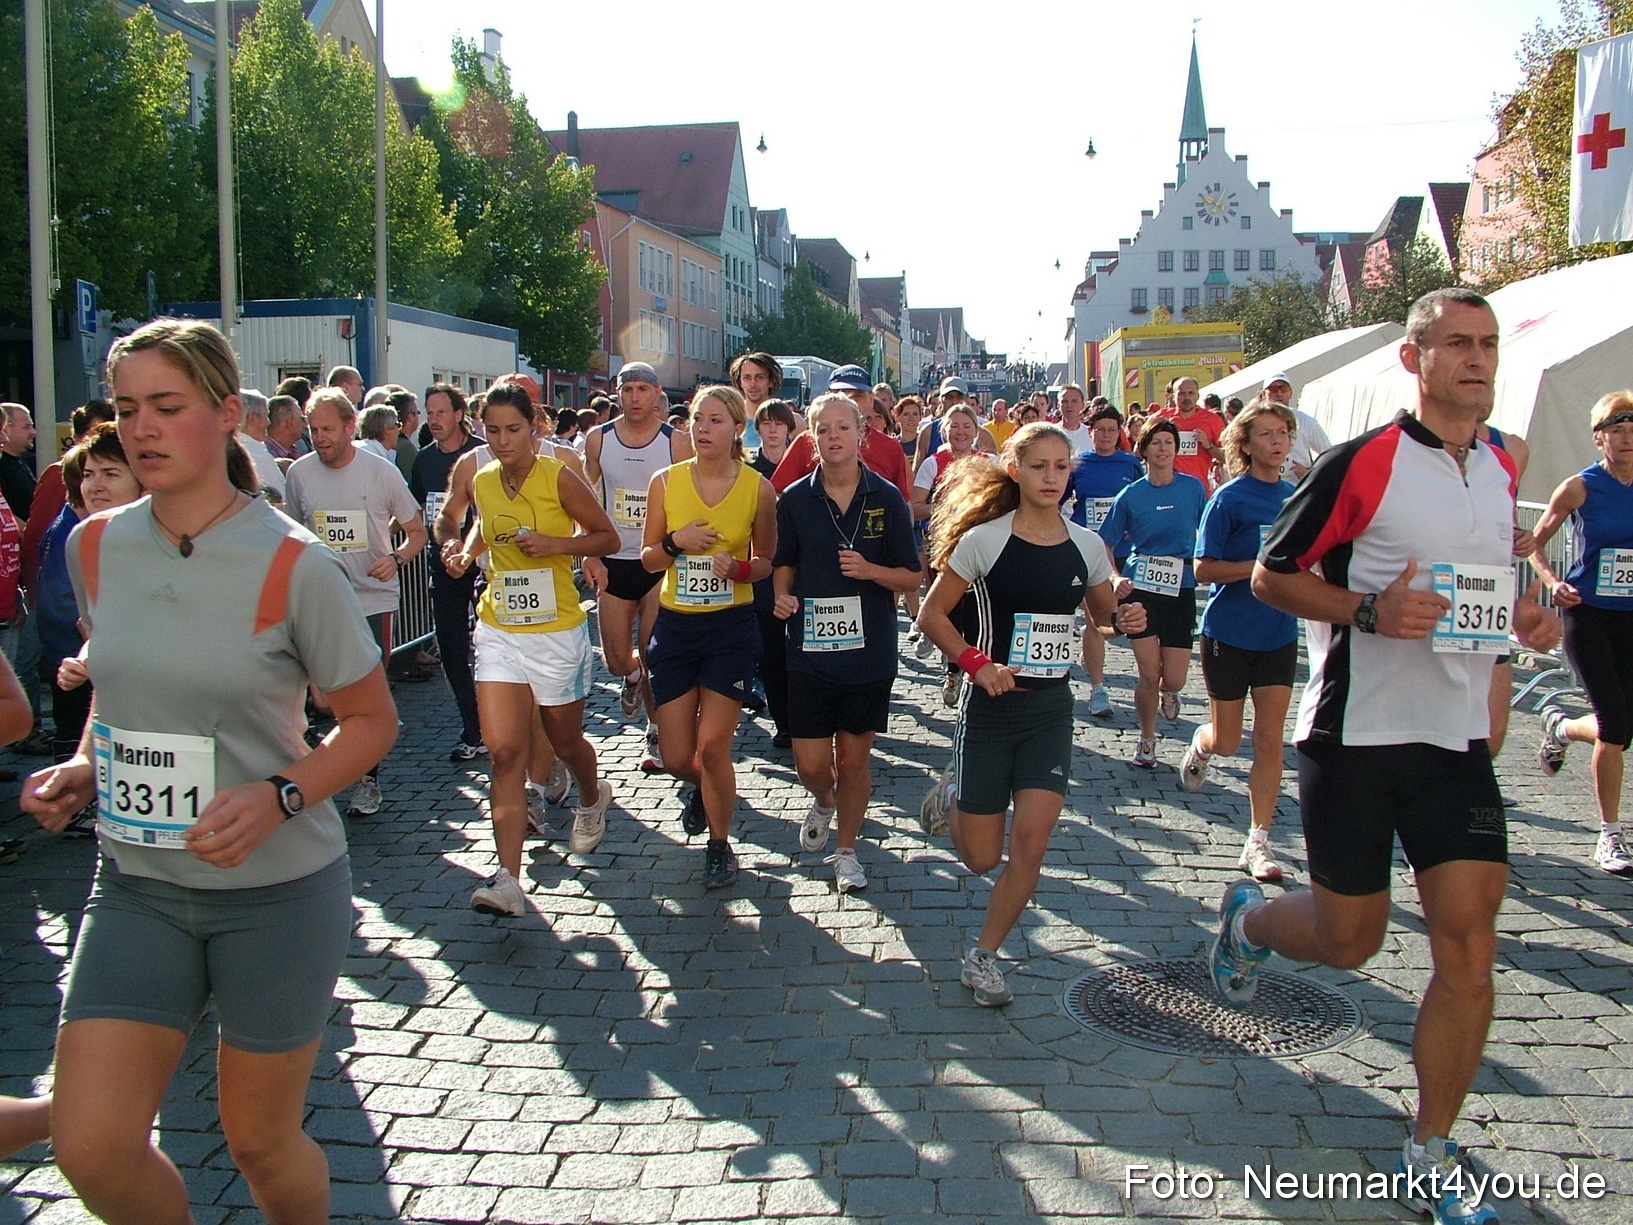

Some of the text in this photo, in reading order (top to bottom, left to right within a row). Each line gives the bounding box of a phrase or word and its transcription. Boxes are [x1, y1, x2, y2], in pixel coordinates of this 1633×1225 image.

[82, 287, 92, 325] P
[326, 515, 348, 524] Klaus
[318, 526, 324, 534] D
[328, 528, 356, 542] 904
[688, 560, 712, 571] Steffi
[1138, 564, 1144, 572] C
[1148, 556, 1174, 568] Brigitte
[1602, 565, 1610, 574] B
[504, 576, 530, 587] Marie
[679, 573, 685, 582] B
[1146, 569, 1178, 586] 3033
[1456, 574, 1496, 592] Roman
[688, 577, 728, 593] 2381
[494, 591, 501, 601] C
[508, 592, 540, 610] 598
[814, 604, 845, 615] Verena
[806, 618, 812, 627] B
[1457, 603, 1508, 631] 3316
[816, 619, 859, 637] 2364
[1032, 621, 1070, 633] Vanessa
[1016, 636, 1025, 647] C
[1031, 641, 1070, 661] 3315
[113, 741, 175, 768] Marion
[99, 765, 107, 783] B
[116, 779, 199, 818] 3311
